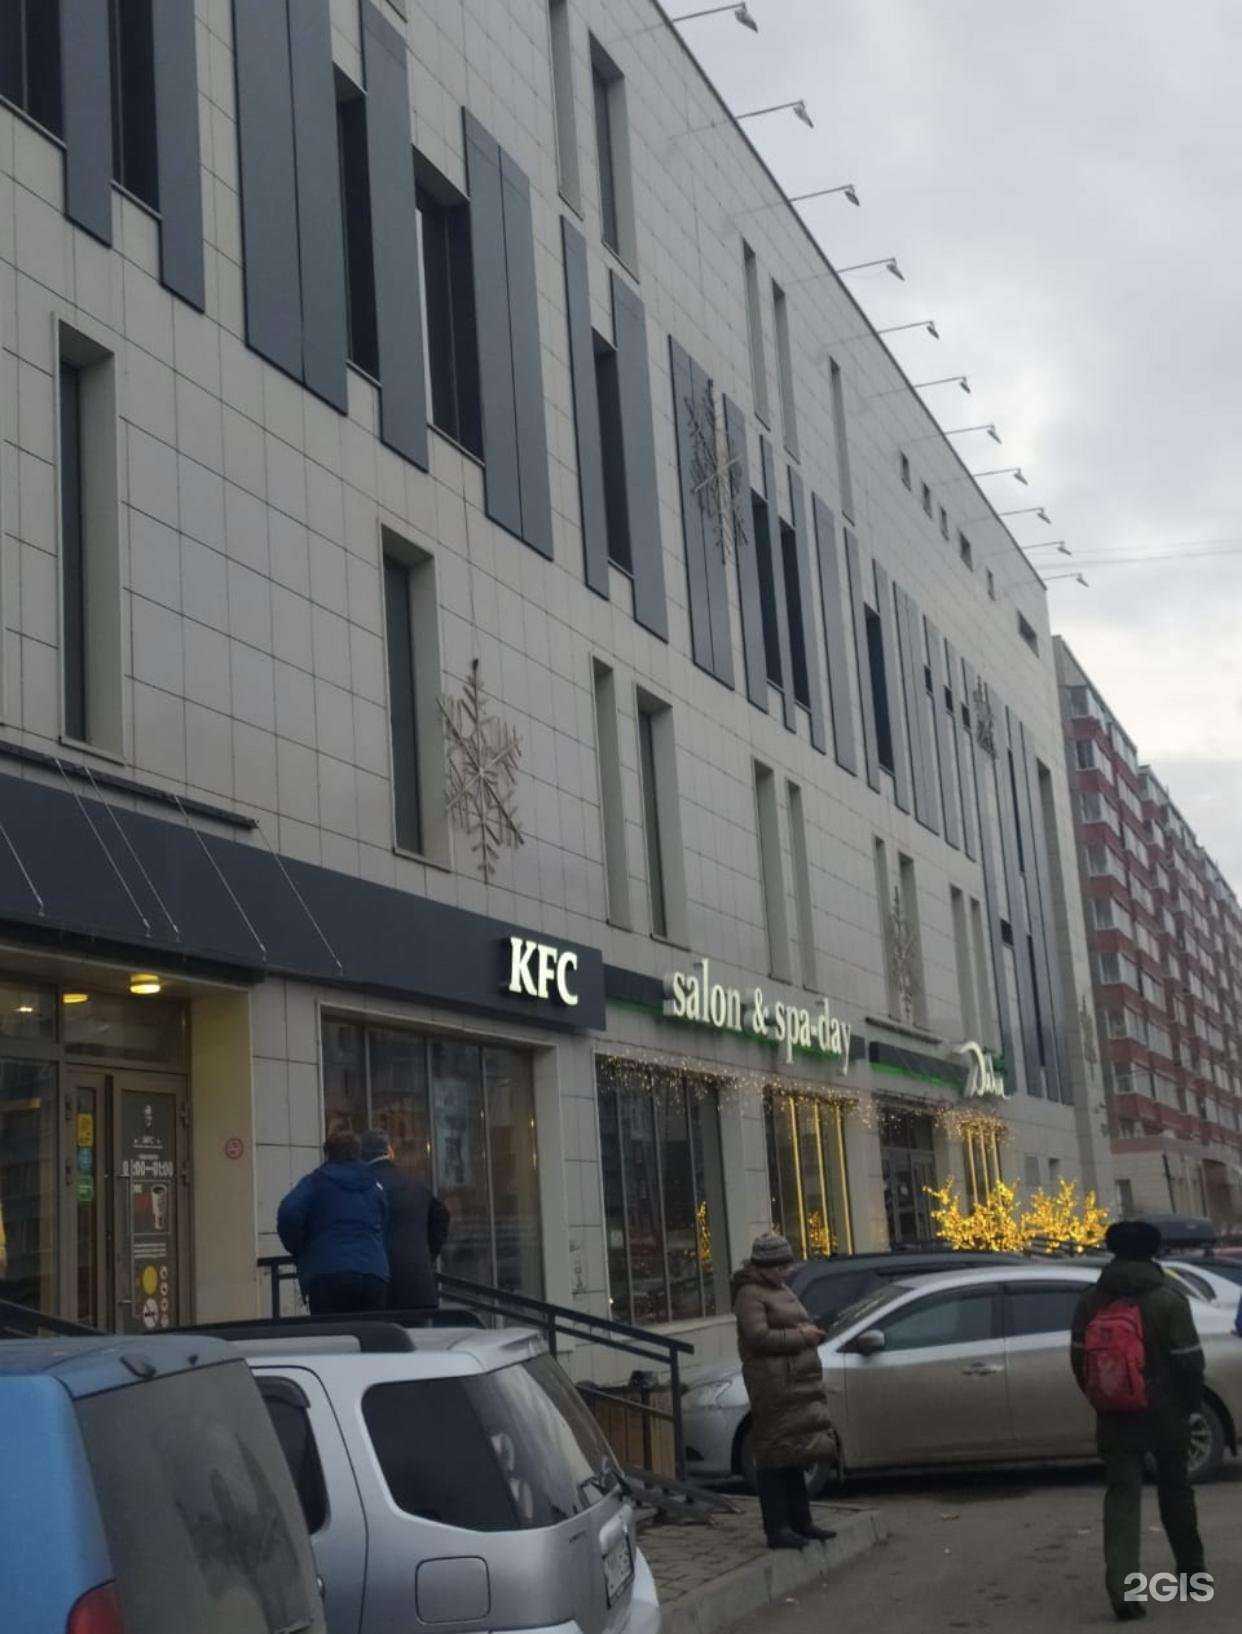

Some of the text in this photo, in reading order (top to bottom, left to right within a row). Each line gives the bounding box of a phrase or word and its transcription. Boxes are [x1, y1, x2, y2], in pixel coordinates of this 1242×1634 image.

[509, 936, 578, 1005] KFC
[673, 958, 850, 1075] salon & spa-day
